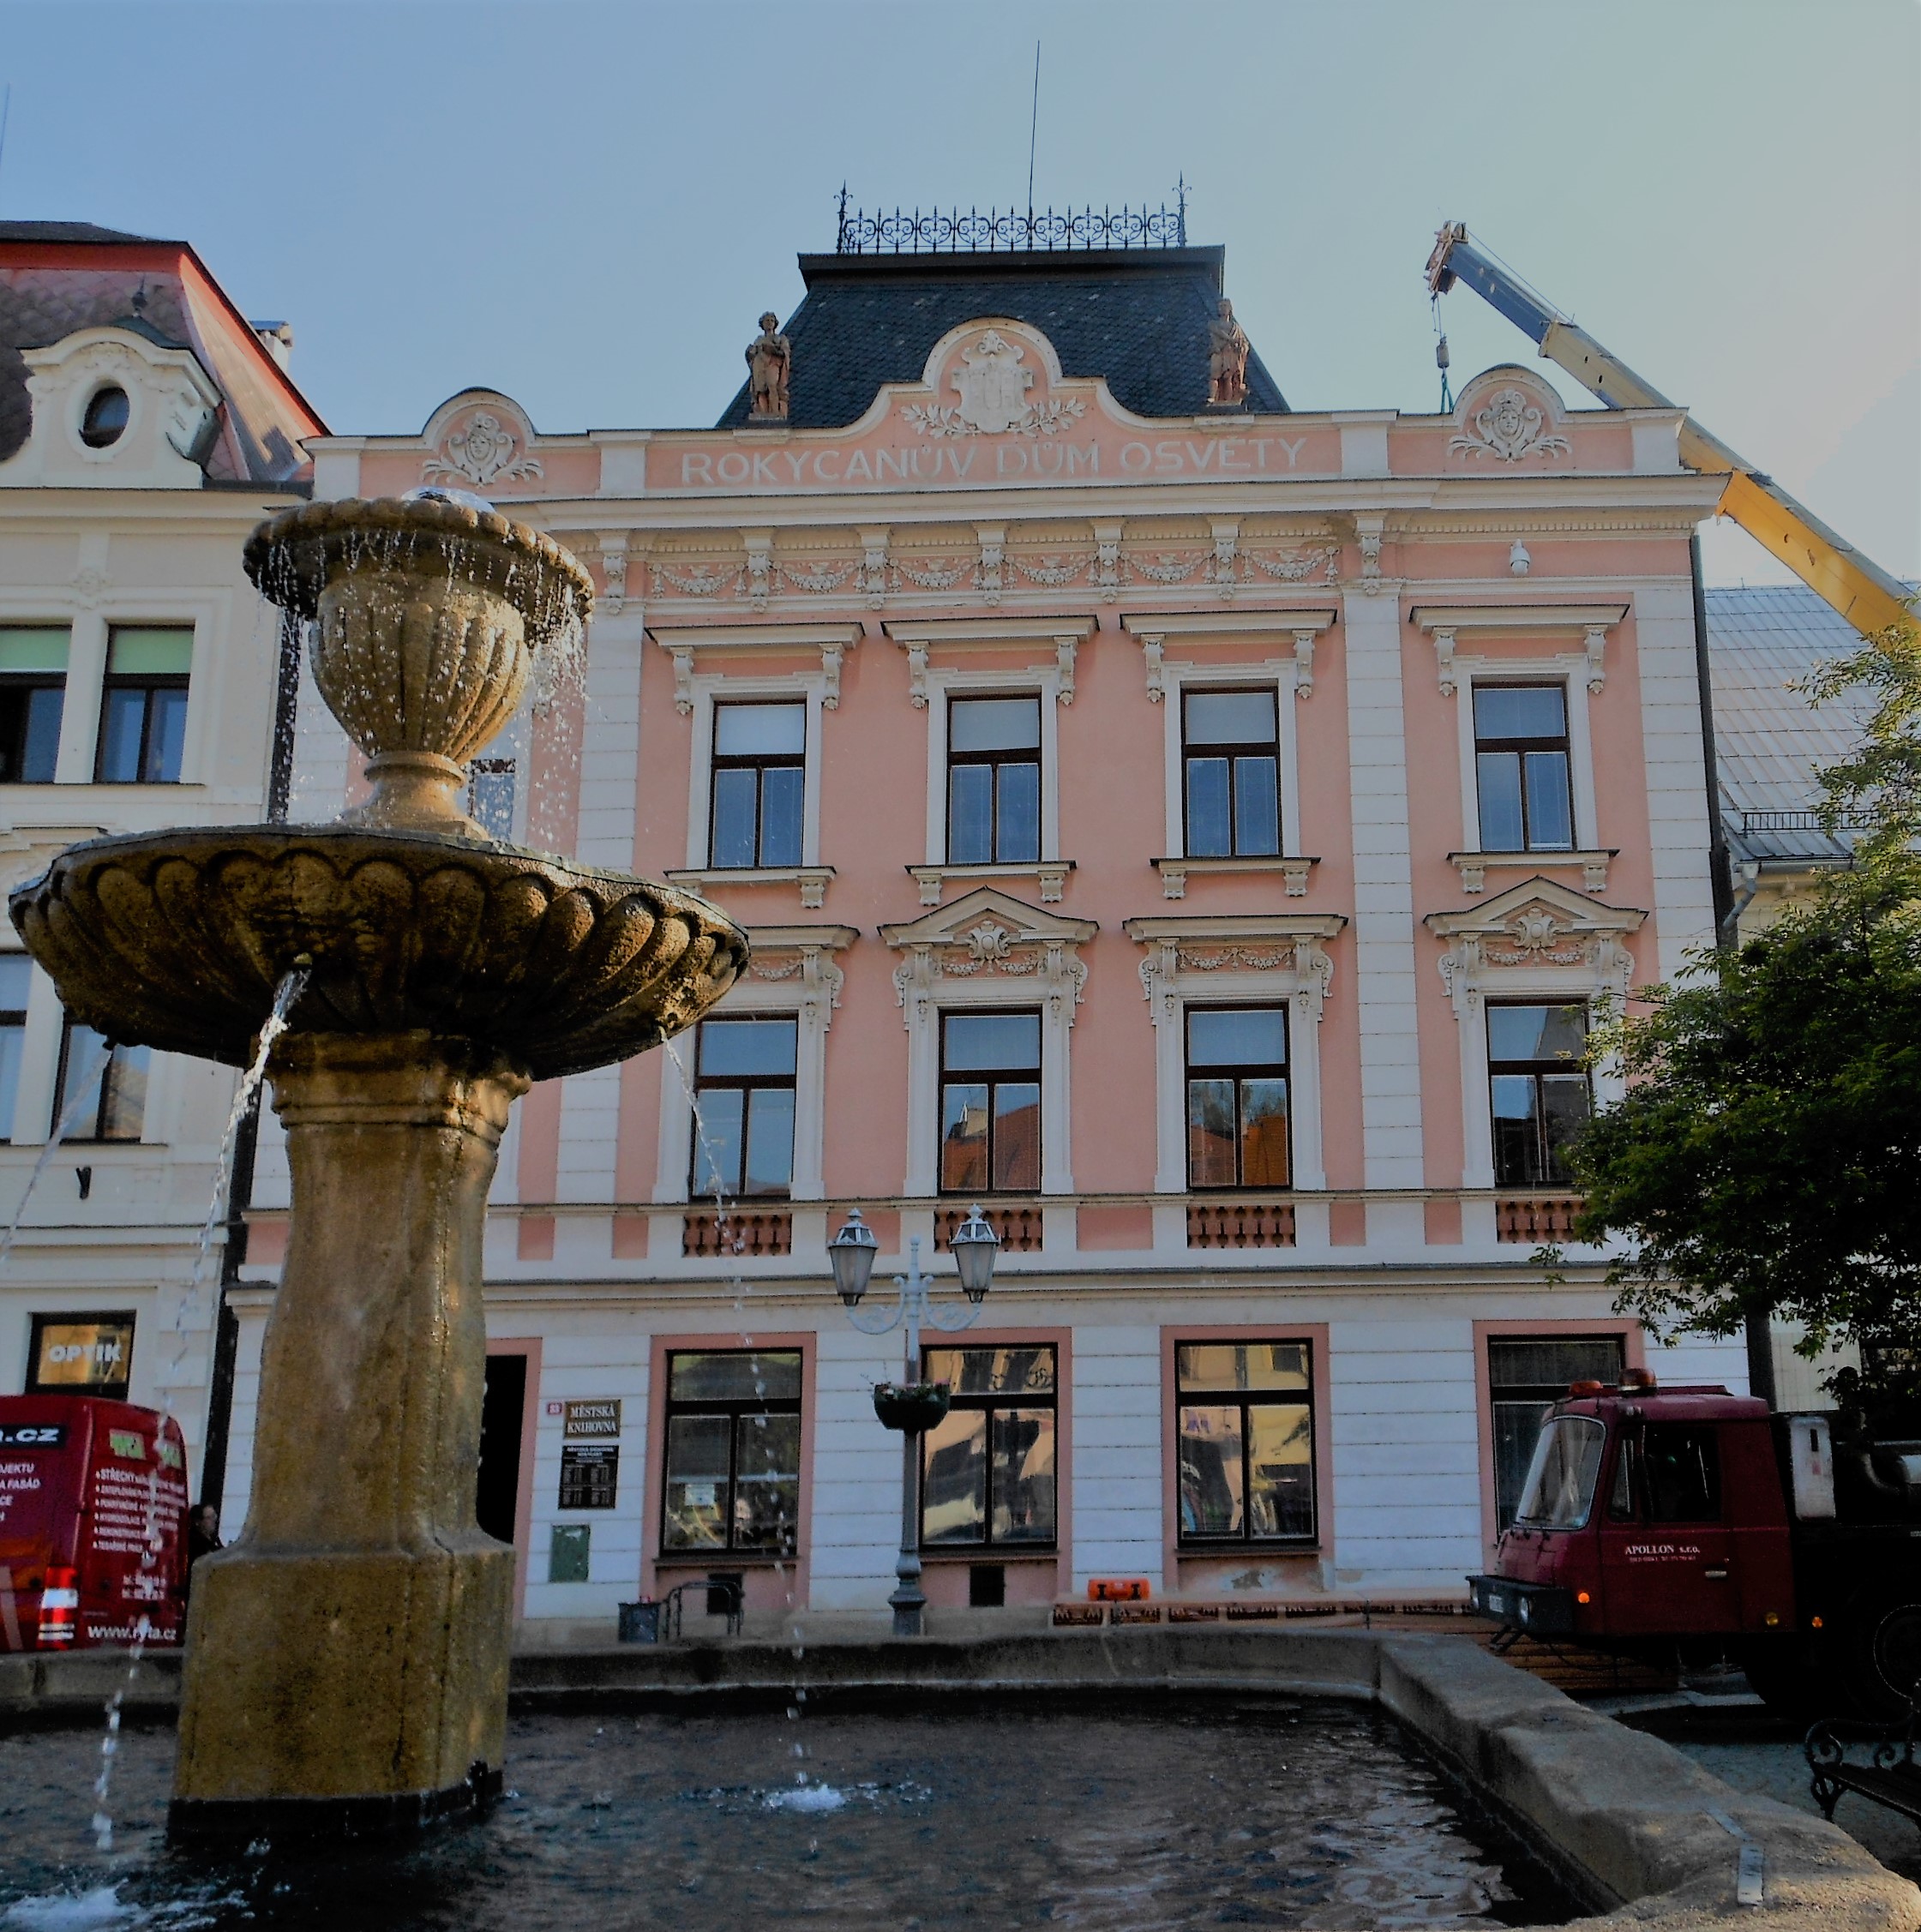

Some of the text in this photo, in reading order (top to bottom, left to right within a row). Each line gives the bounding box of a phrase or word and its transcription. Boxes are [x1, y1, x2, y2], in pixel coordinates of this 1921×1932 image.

[681, 435, 1307, 485] ROKYCANŮV DŮM OSVĚTY
[49, 1344, 122, 1362] OPTIK
[570, 1404, 615, 1419] MĚSTSKÁ
[0, 1427, 59, 1443] .cz
[567, 1421, 616, 1434] KNIHOVNA
[1625, 1545, 1674, 1555] APOLLON
